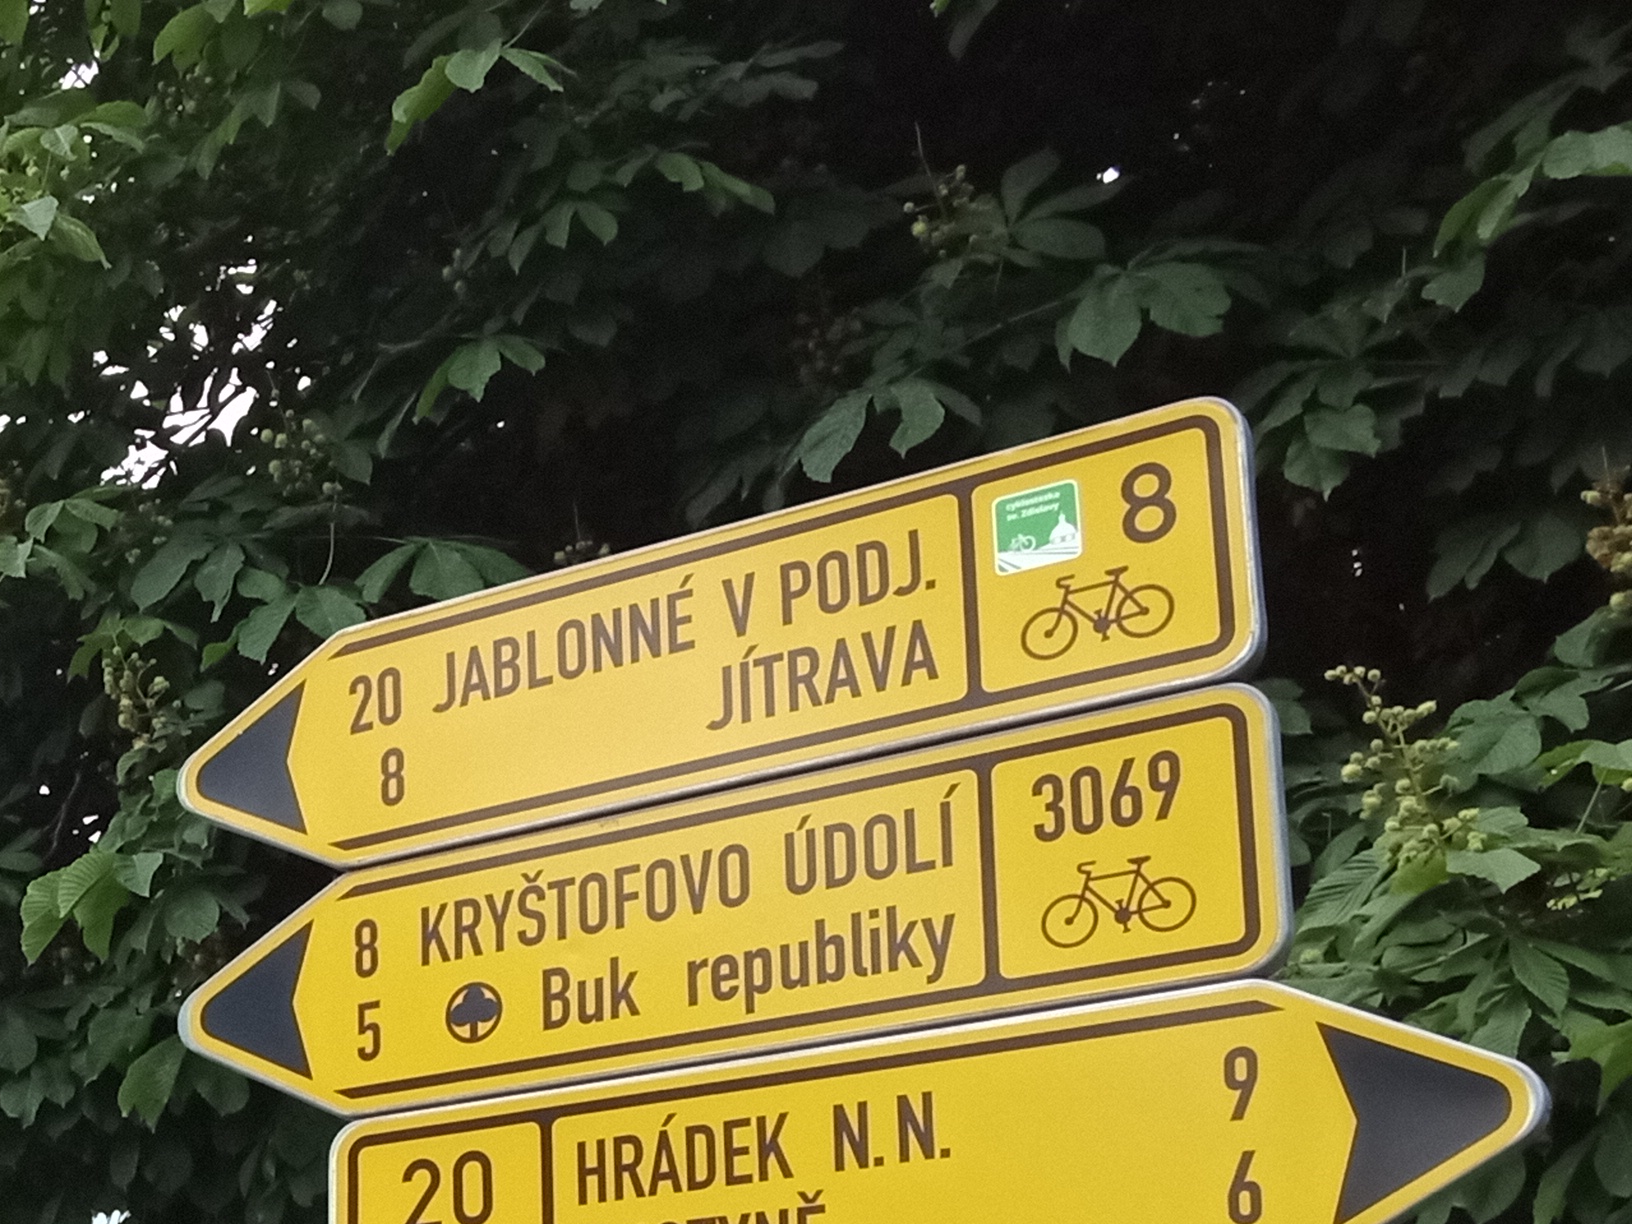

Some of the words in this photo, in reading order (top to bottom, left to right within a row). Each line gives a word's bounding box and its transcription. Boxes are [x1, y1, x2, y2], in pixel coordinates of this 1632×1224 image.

[1120, 462, 1177, 544] 8
[349, 667, 402, 735] 20
[432, 573, 695, 713] JABLONNÉ
[721, 571, 755, 637] V
[779, 529, 937, 626] PODJ.
[381, 747, 405, 807] 8
[707, 619, 939, 730] JÍTRAVA
[1031, 750, 1181, 843] 3069
[354, 918, 379, 979] 8
[421, 844, 750, 967] KRYŠTOFOVO
[784, 783, 959, 896] ÚDOLÍ
[357, 1000, 381, 1062] 5
[542, 956, 641, 1031] Buk
[687, 905, 955, 1015] republiky
[576, 1111, 794, 1206] HRÁDEK
[1223, 1046, 1258, 1122] 9
